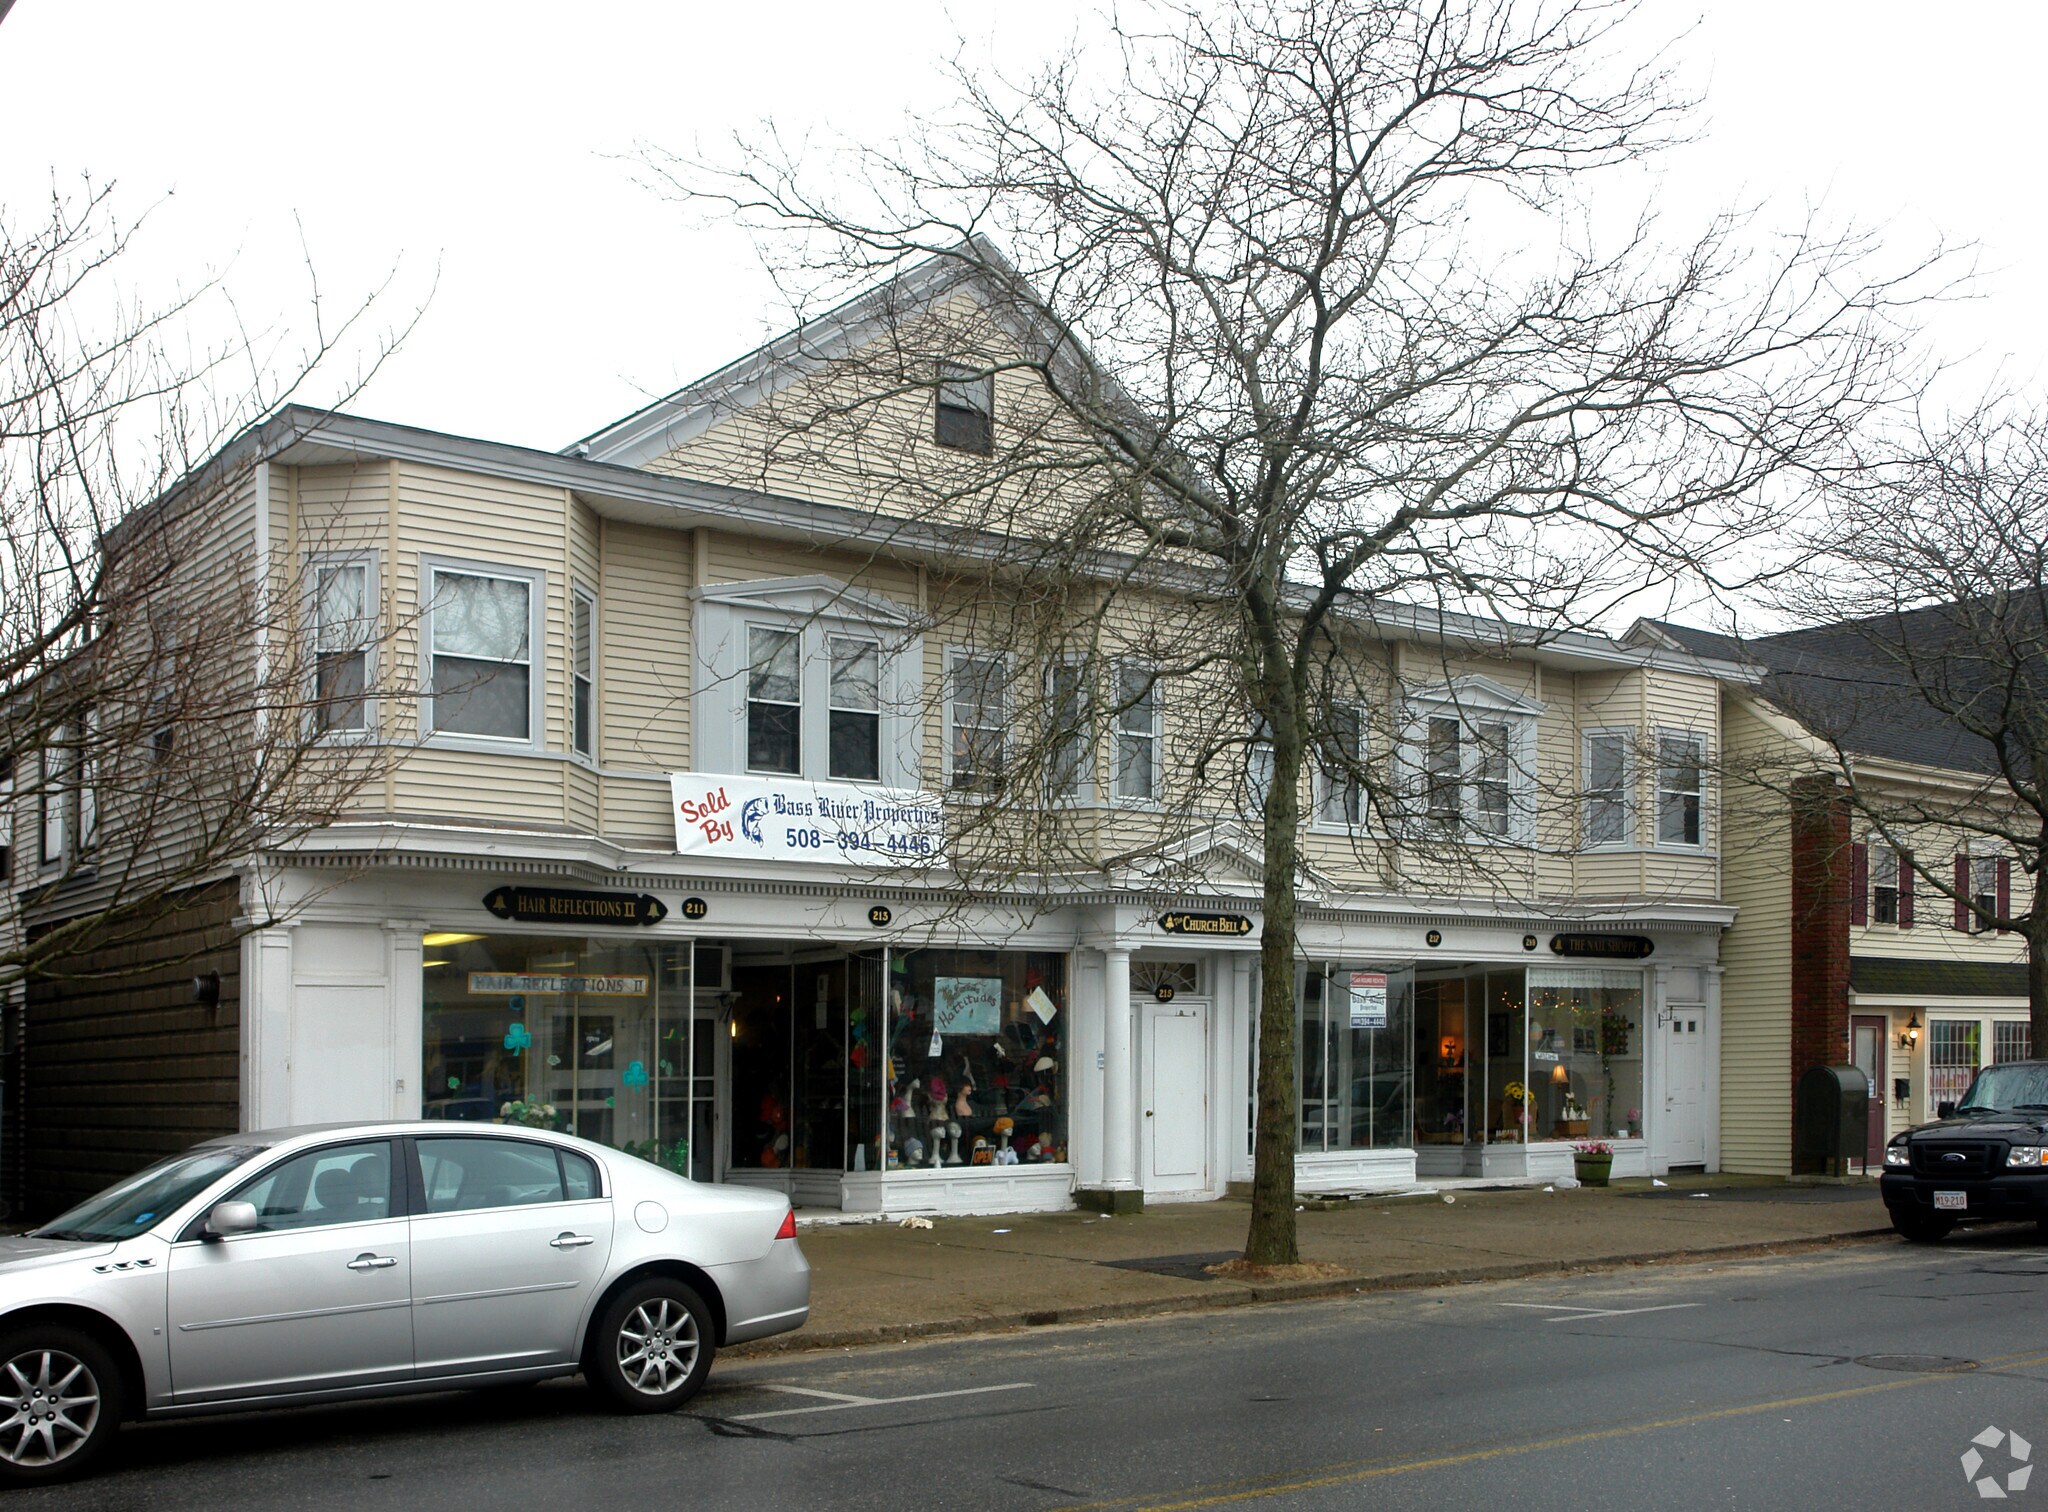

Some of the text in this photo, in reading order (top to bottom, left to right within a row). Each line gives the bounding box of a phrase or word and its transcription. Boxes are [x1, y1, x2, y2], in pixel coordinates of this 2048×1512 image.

[680, 786, 732, 824] Sold
[772, 793, 940, 827] Bass River Properties
[699, 819, 735, 844] By
[786, 827, 931, 855] 508-394-4446
[517, 895, 636, 918] HAIR REFLECTIONS II
[685, 902, 704, 914] 211
[872, 910, 889, 921] 213
[1182, 915, 1219, 932] CHURCH
[1219, 917, 1239, 933] BELL
[1570, 938, 1585, 951] THE
[475, 976, 513, 990] HAIR
[522, 976, 624, 992] REFLECTIONS
[938, 992, 997, 1029] Hattitudes
